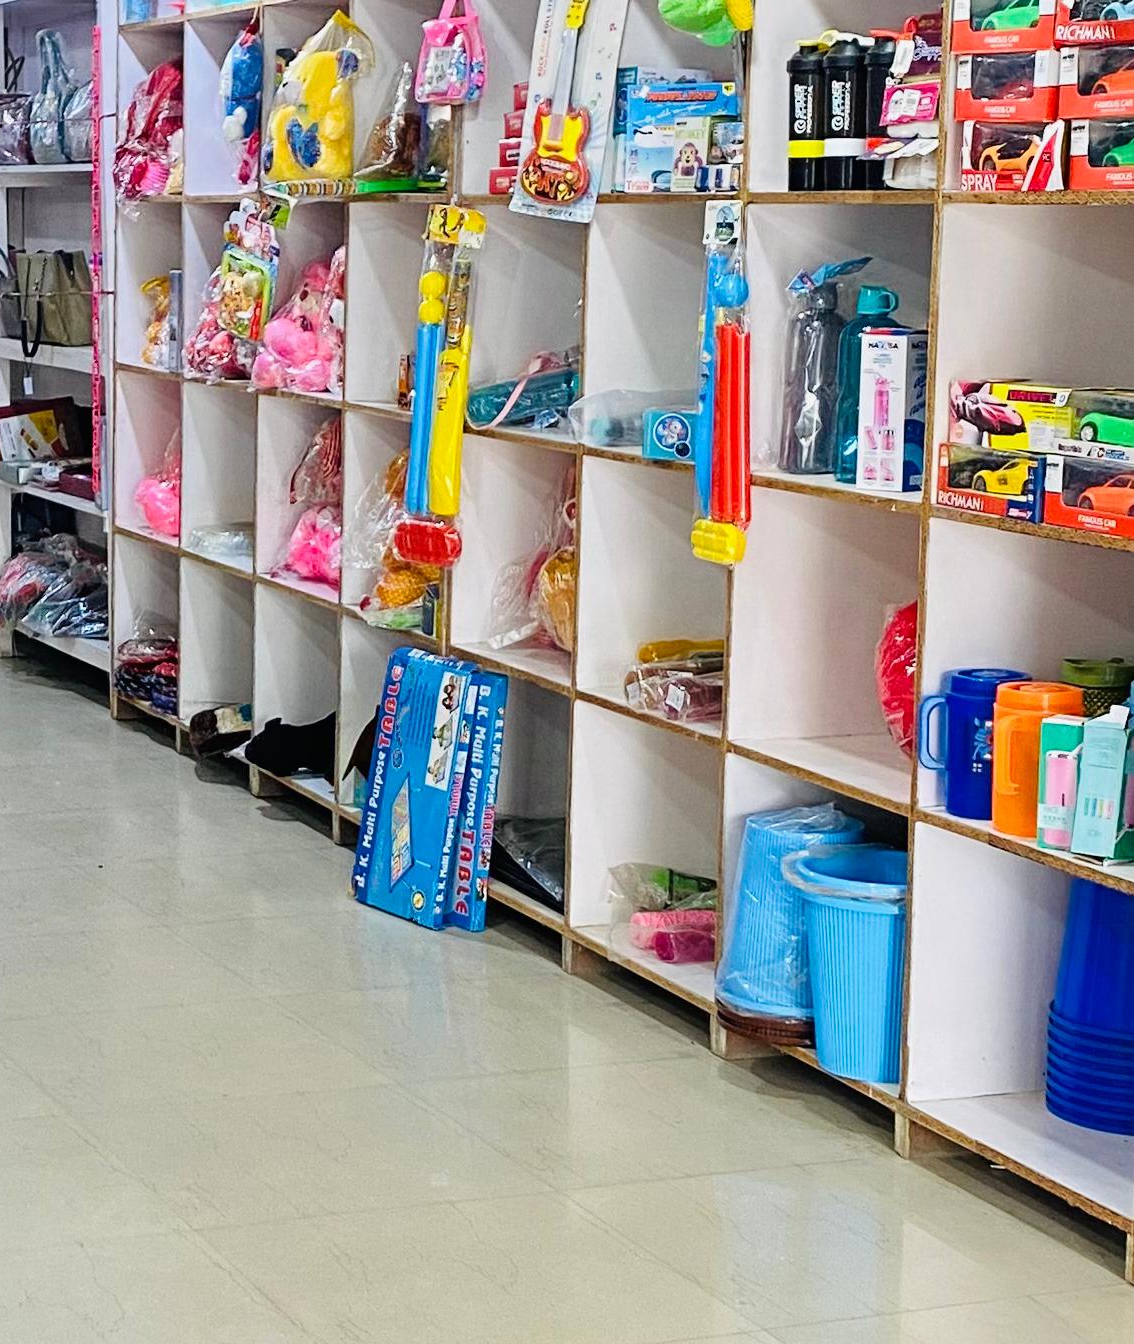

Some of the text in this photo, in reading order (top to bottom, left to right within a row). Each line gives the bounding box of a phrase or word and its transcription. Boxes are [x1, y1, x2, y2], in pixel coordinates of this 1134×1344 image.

[961, 174, 998, 192] SPRAY
[358, 853, 370, 867] K.
[368, 751, 386, 808] Purpose
[377, 664, 404, 749] TABLE
[465, 768, 484, 831] Purpose
[454, 830, 476, 917] TABLE
